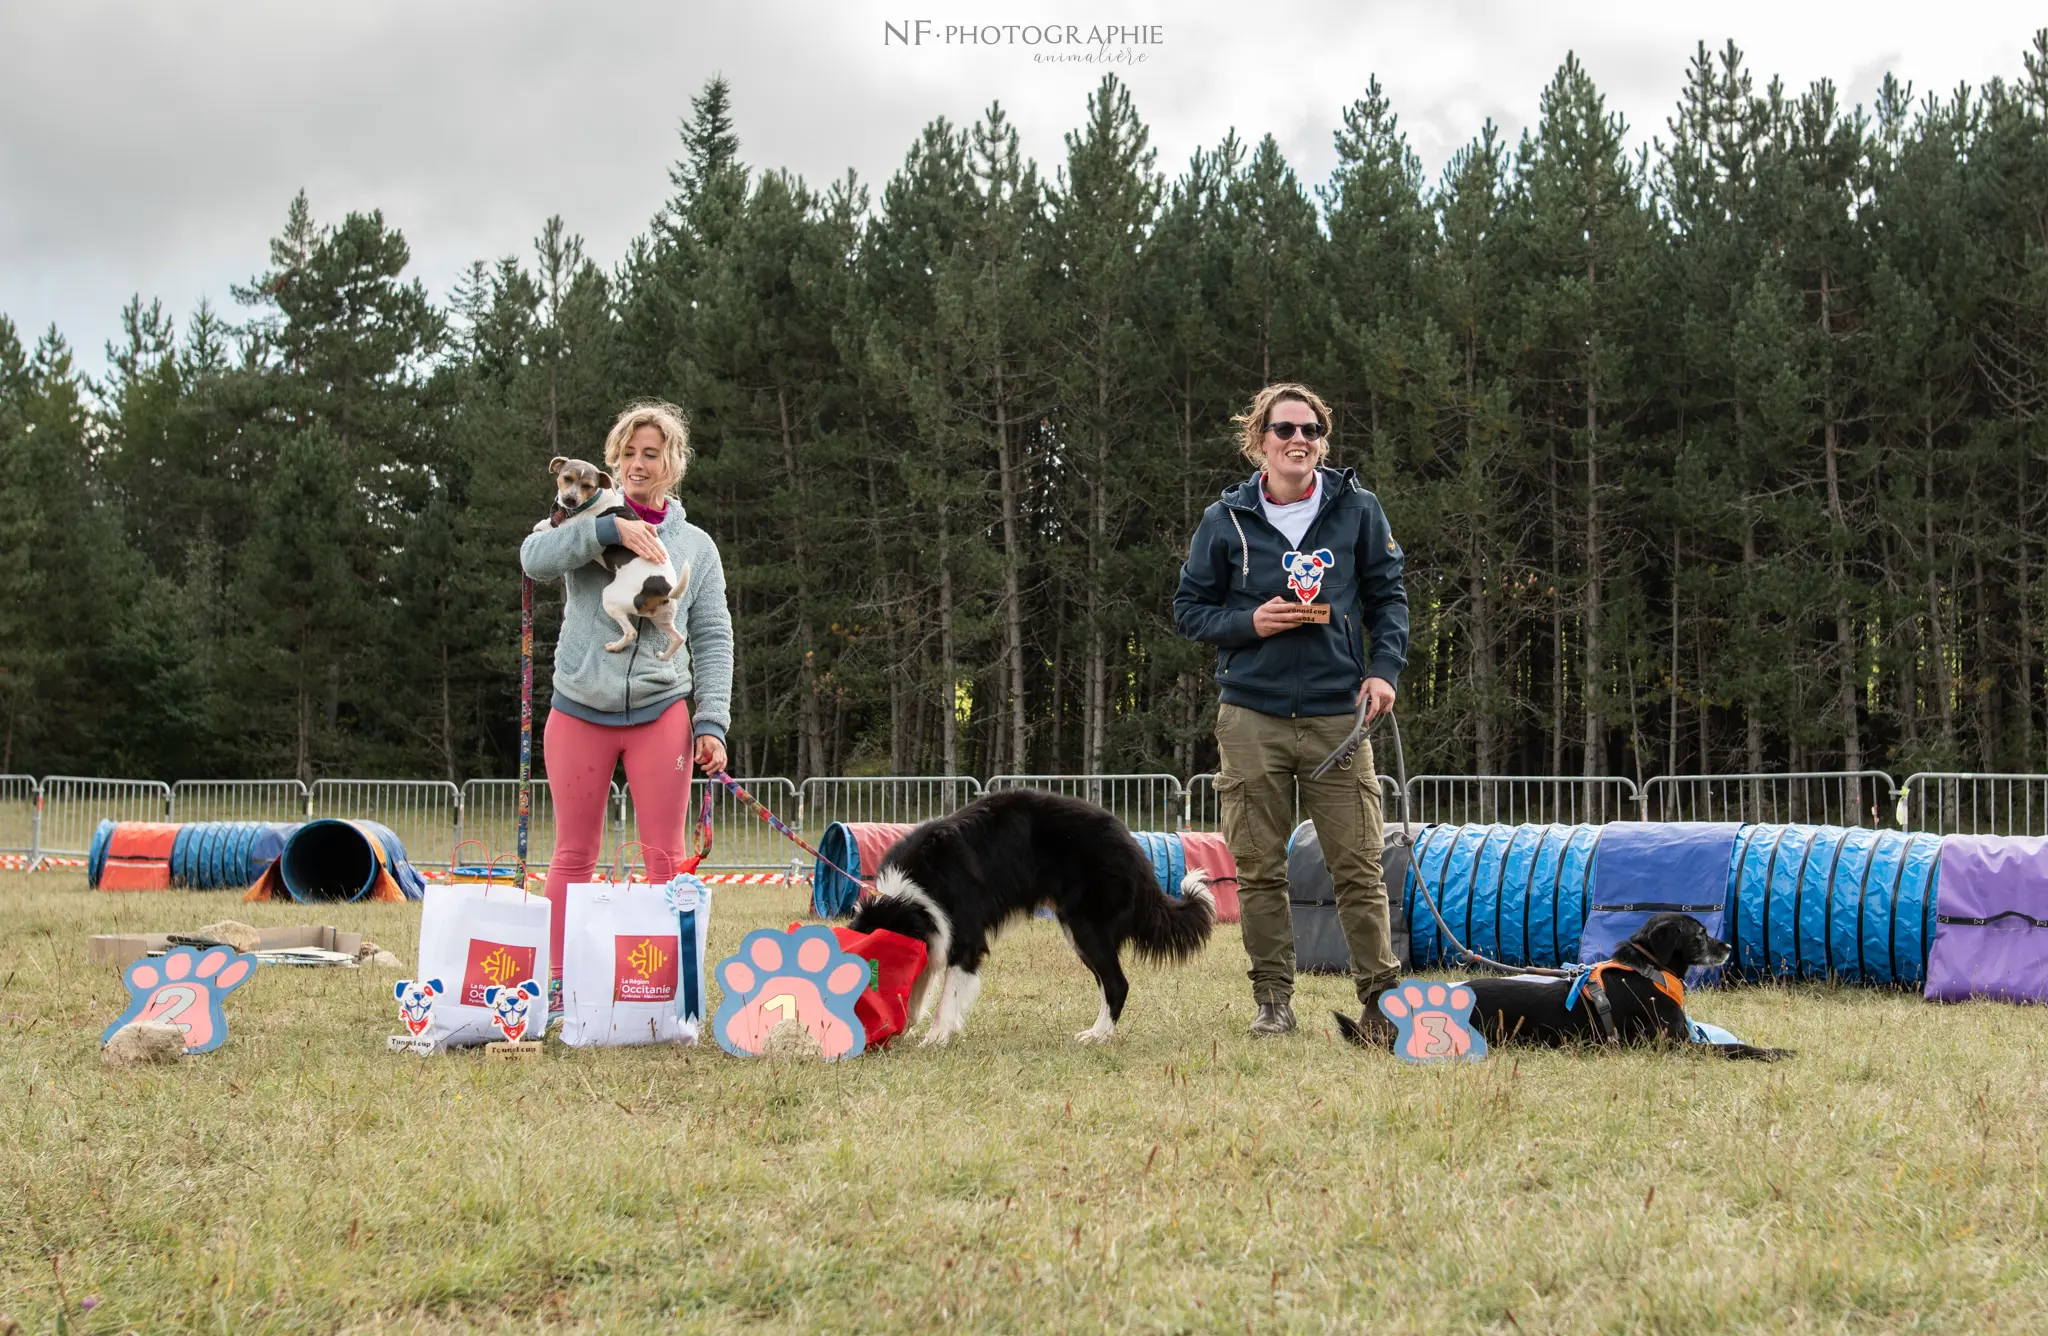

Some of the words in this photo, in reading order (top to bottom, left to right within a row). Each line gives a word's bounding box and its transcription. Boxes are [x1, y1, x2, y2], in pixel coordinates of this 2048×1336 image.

[621, 984, 671, 994] Occitanie
[152, 986, 197, 1033] 2
[763, 994, 797, 1021] 1
[1421, 1017, 1453, 1055] 3
